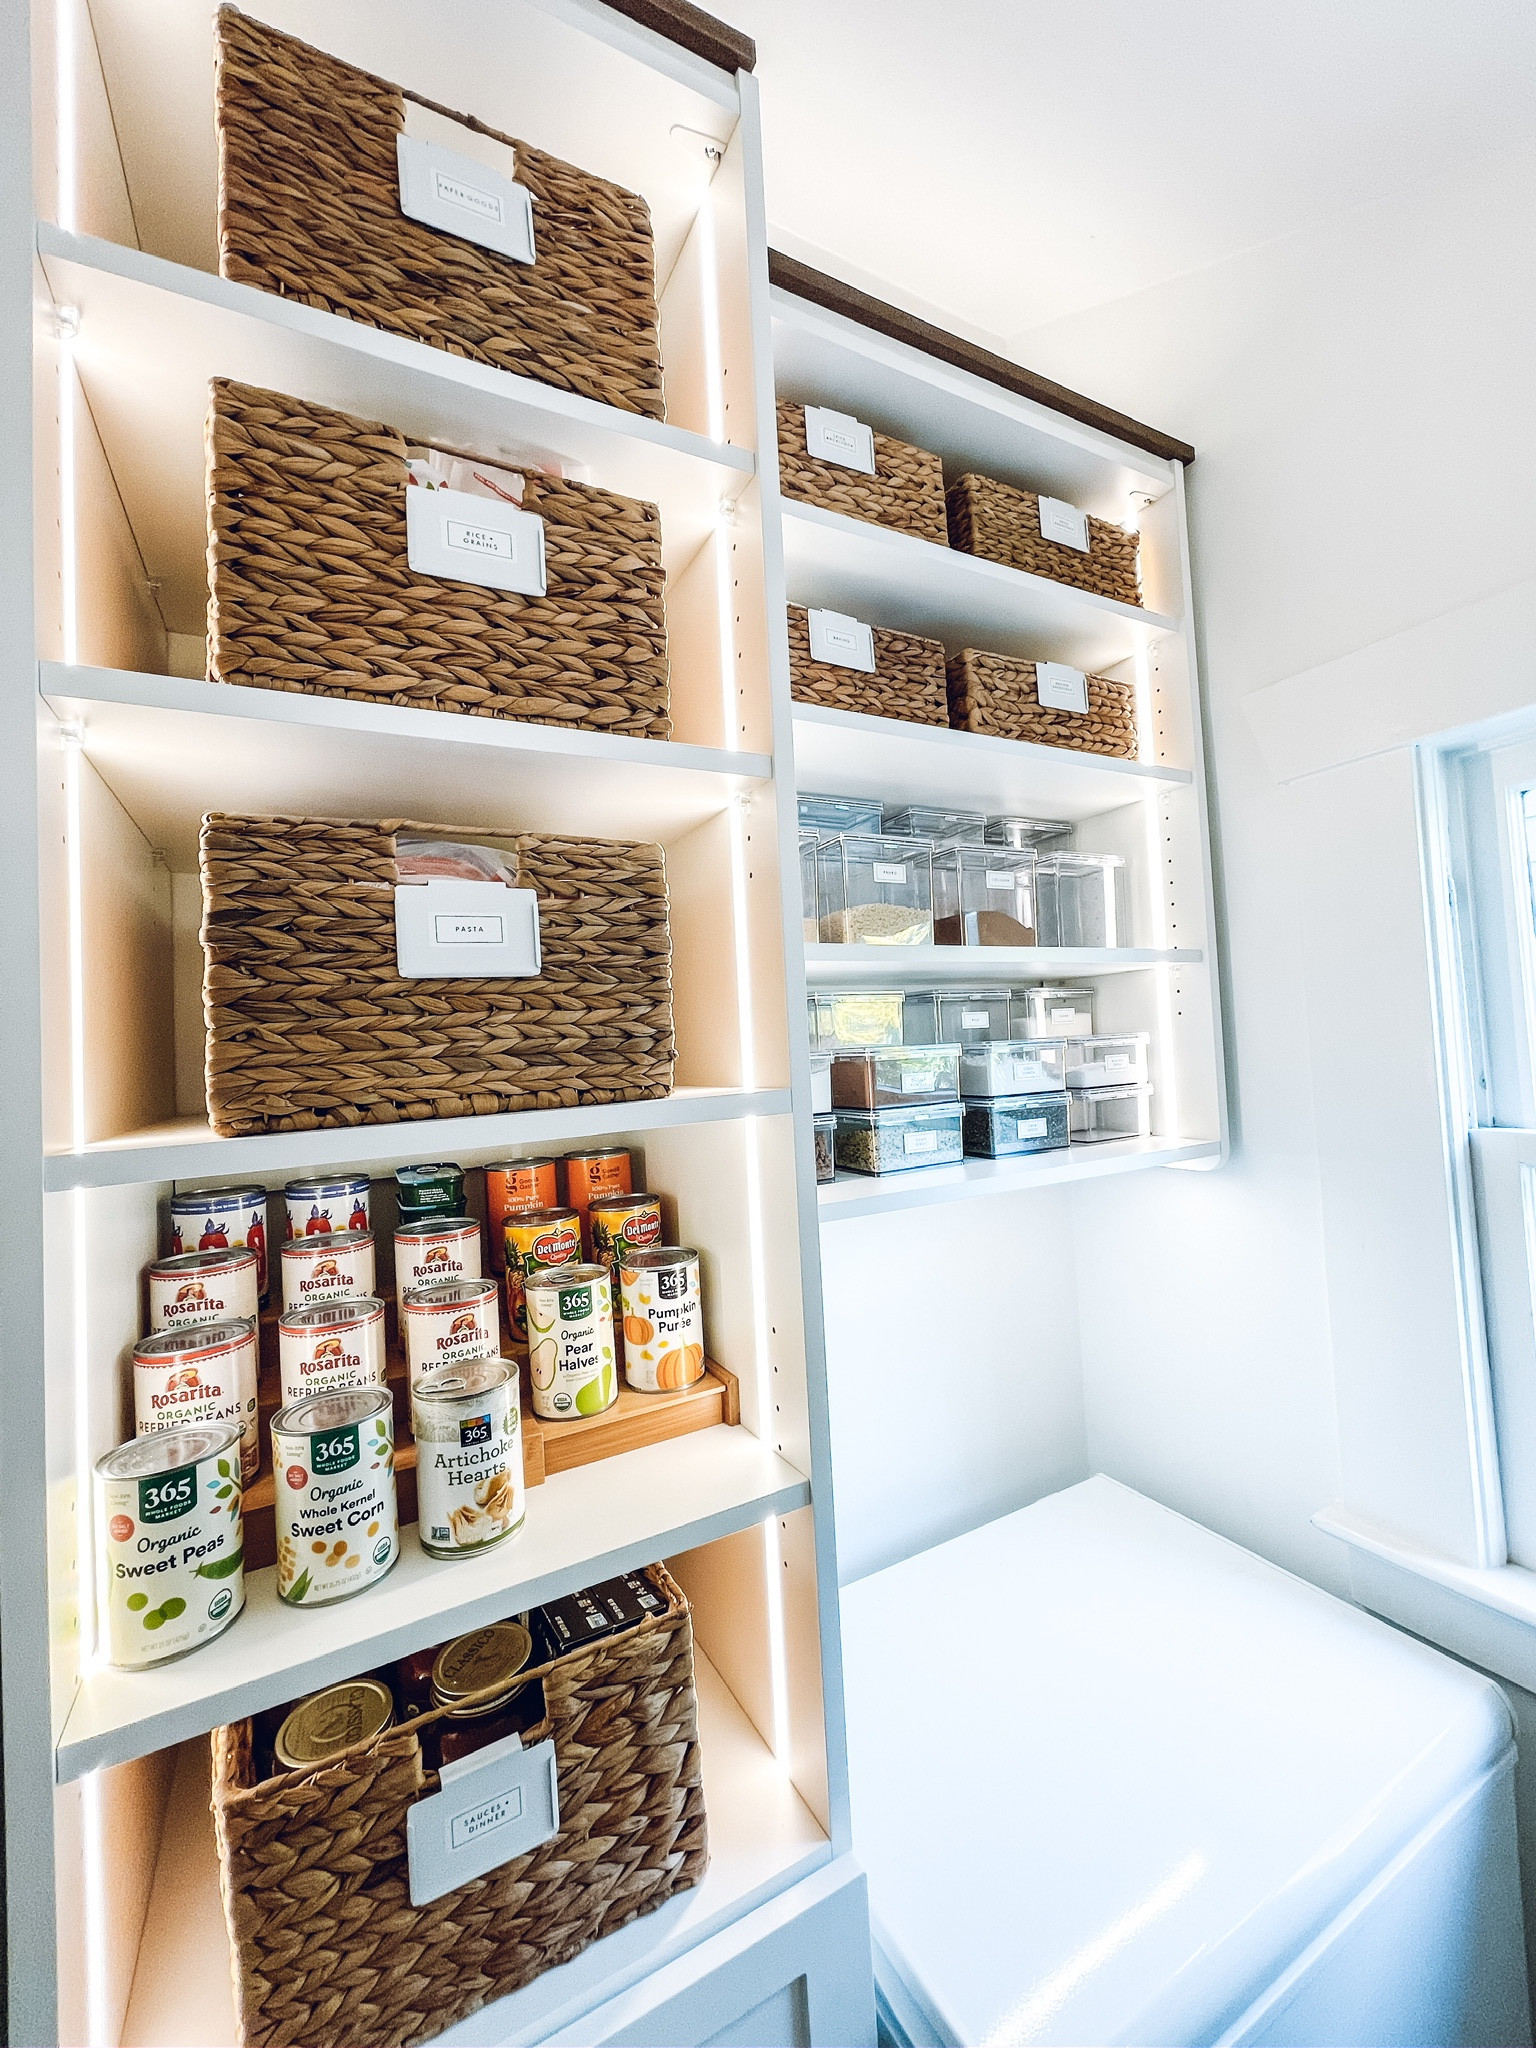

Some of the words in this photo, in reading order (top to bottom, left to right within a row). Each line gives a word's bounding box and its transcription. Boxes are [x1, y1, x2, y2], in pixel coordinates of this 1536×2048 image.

[463, 537, 498, 551] GRAINS
[466, 530, 486, 541] RICE
[588, 1190, 624, 1201] Pumpkin
[504, 1200, 544, 1212] Pumpkin
[626, 1225, 640, 1236] Del
[537, 1244, 552, 1255] Del
[552, 1239, 575, 1253] Monte
[413, 1259, 463, 1277] Rosarita
[300, 1274, 354, 1292] Rosarita
[418, 1274, 460, 1286] ORGANIC
[661, 1272, 685, 1290] 365
[304, 1289, 350, 1302] ORGANIC
[562, 1291, 590, 1311] 365
[163, 1298, 225, 1317] Rosarita
[648, 1301, 697, 1320] Pumpkin
[168, 1313, 219, 1327] ORGANIC
[659, 1317, 692, 1333] Purée
[436, 1327, 489, 1350] Rosarita
[561, 1326, 595, 1342] Organic
[565, 1342, 594, 1356] Pear
[300, 1353, 361, 1375] Rosarita
[559, 1355, 598, 1372] Halves
[305, 1370, 356, 1386] ORGANIC
[151, 1384, 222, 1409] Rosarita
[157, 1401, 217, 1421] ORGANIC
[464, 1425, 487, 1443] 365
[315, 1435, 355, 1462] 365
[434, 1437, 514, 1470] Artichoke
[325, 1462, 347, 1471] MARKET
[337, 1455, 355, 1464] FOODS
[447, 1460, 507, 1487] Hearts
[144, 1477, 191, 1509] 365
[310, 1478, 364, 1502] Organic
[145, 1507, 168, 1517] WHOLE
[169, 1499, 192, 1510] FOODS
[300, 1506, 338, 1519] Whole
[340, 1488, 376, 1512] Kernel
[155, 1508, 182, 1519] MARKET
[291, 1518, 343, 1538] Sweet
[347, 1500, 385, 1527] Corn
[136, 1526, 202, 1554] Organic
[115, 1555, 177, 1579] Sweet
[183, 1533, 225, 1566] Peas
[444, 1628, 495, 1678] CLASSICO
[464, 1802, 502, 1827] SAUCES
[468, 1809, 506, 1834] DINNER
